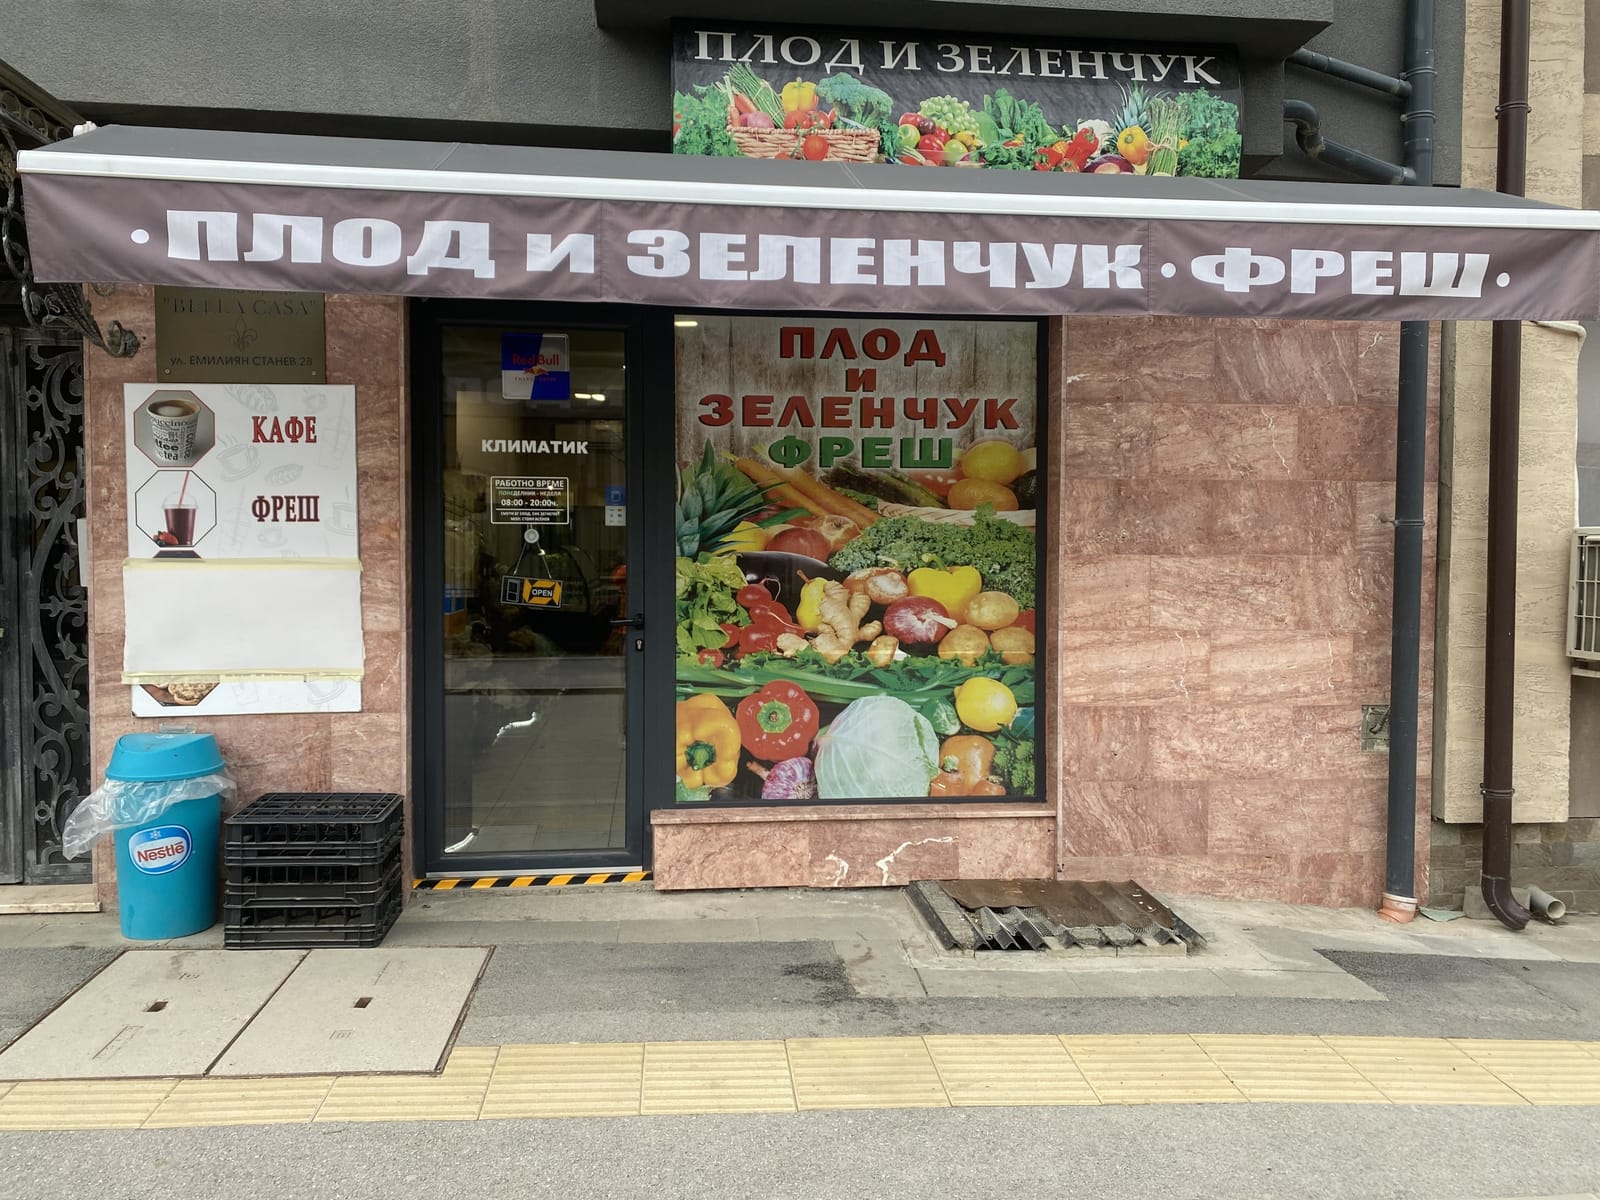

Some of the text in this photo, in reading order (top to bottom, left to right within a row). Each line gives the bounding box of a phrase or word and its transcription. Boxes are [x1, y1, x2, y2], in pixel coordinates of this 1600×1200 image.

[694, 30, 1221, 85] ПЛОД И ЗЕЛЕНЧУК
[166, 209, 496, 279] ПЛОД
[626, 229, 1145, 290] ЗЕЛЕНЧУК
[1191, 247, 1490, 298] ФРЕШ
[512, 352, 560, 366] Red Bull
[779, 326, 946, 367] ПЛОД
[170, 355, 313, 367] ул. ЕМИЛИЯН СТАНЕВ 28
[698, 394, 1020, 430] ЗЕЛЕНЧУК
[251, 415, 318, 444] КАФЕ
[481, 439, 589, 455] КЛИМАТИК
[768, 435, 953, 468] ФРЕШ
[495, 479, 565, 489] РАБОТНО ВРЕМЕ
[251, 495, 320, 522] ФРЕШ
[501, 499, 524, 507] 08:00
[532, 588, 553, 597] OPEN
